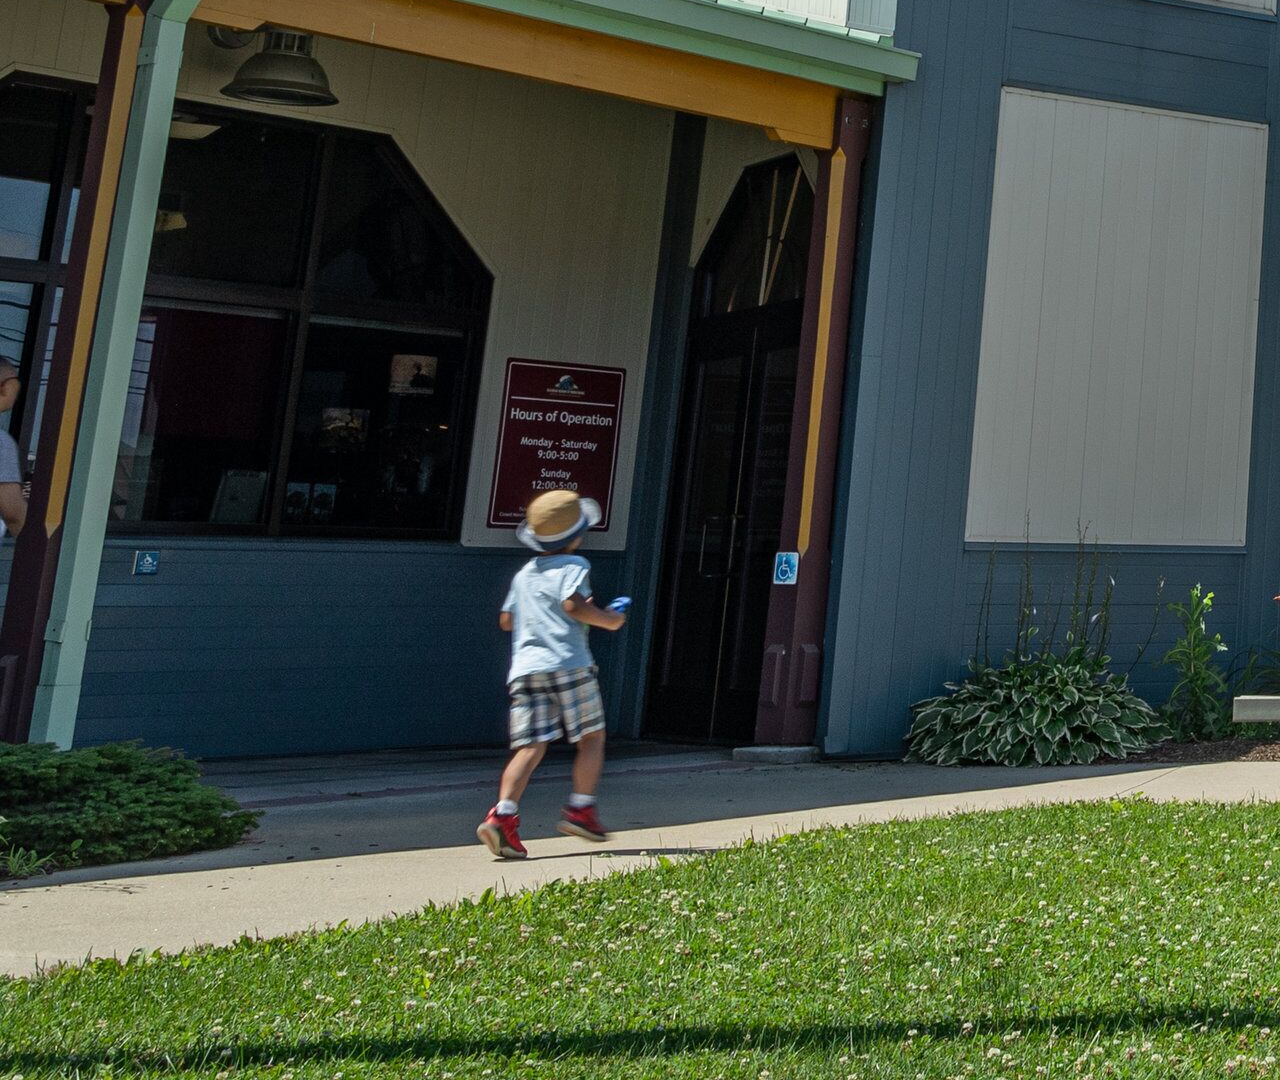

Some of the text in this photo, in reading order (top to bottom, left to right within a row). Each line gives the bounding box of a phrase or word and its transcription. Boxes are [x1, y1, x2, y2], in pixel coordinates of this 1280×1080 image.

[511, 407, 613, 426] Hours of Operation
[520, 436, 553, 449] Monday
[561, 439, 598, 452] Saturday
[537, 450, 579, 460] 9:00-5:00
[540, 468, 571, 480] Sunday
[532, 481, 578, 491] 12:00-5:00
